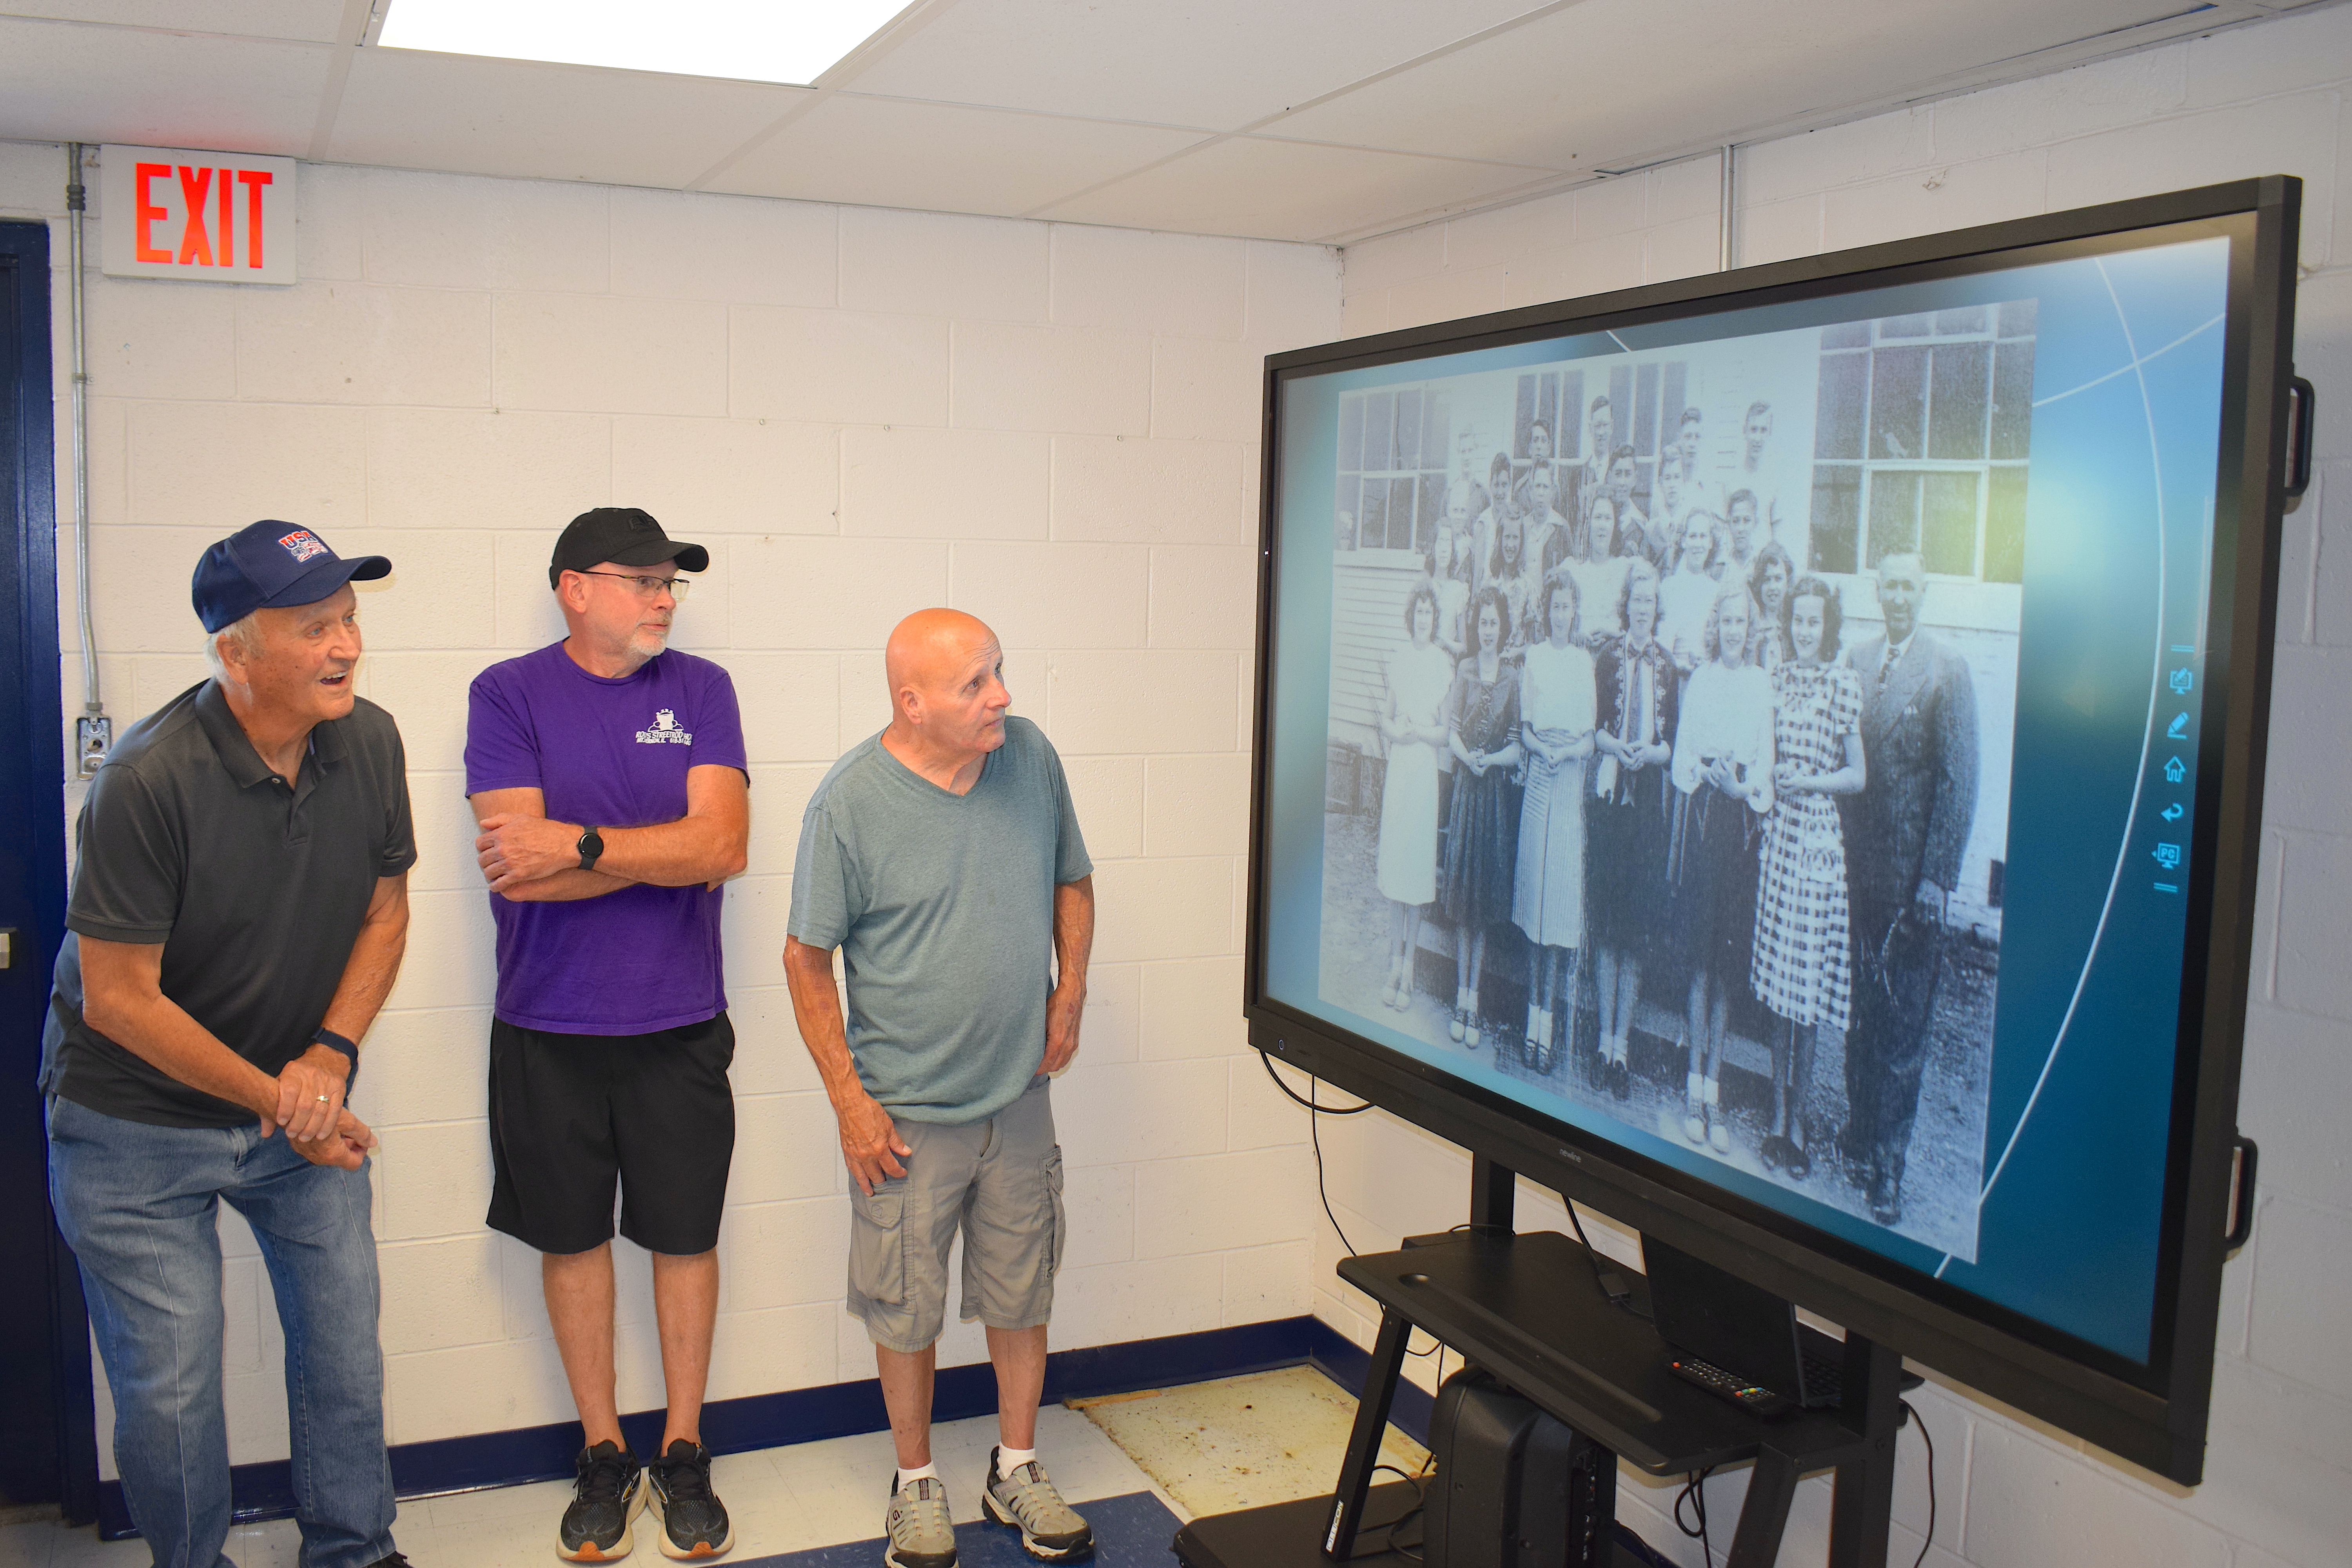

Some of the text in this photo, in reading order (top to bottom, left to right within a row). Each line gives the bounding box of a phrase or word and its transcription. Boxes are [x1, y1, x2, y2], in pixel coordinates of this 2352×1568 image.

[136, 163, 272, 268] EXIT
[278, 531, 318, 550] USA
[2161, 848, 2175, 859] PC
